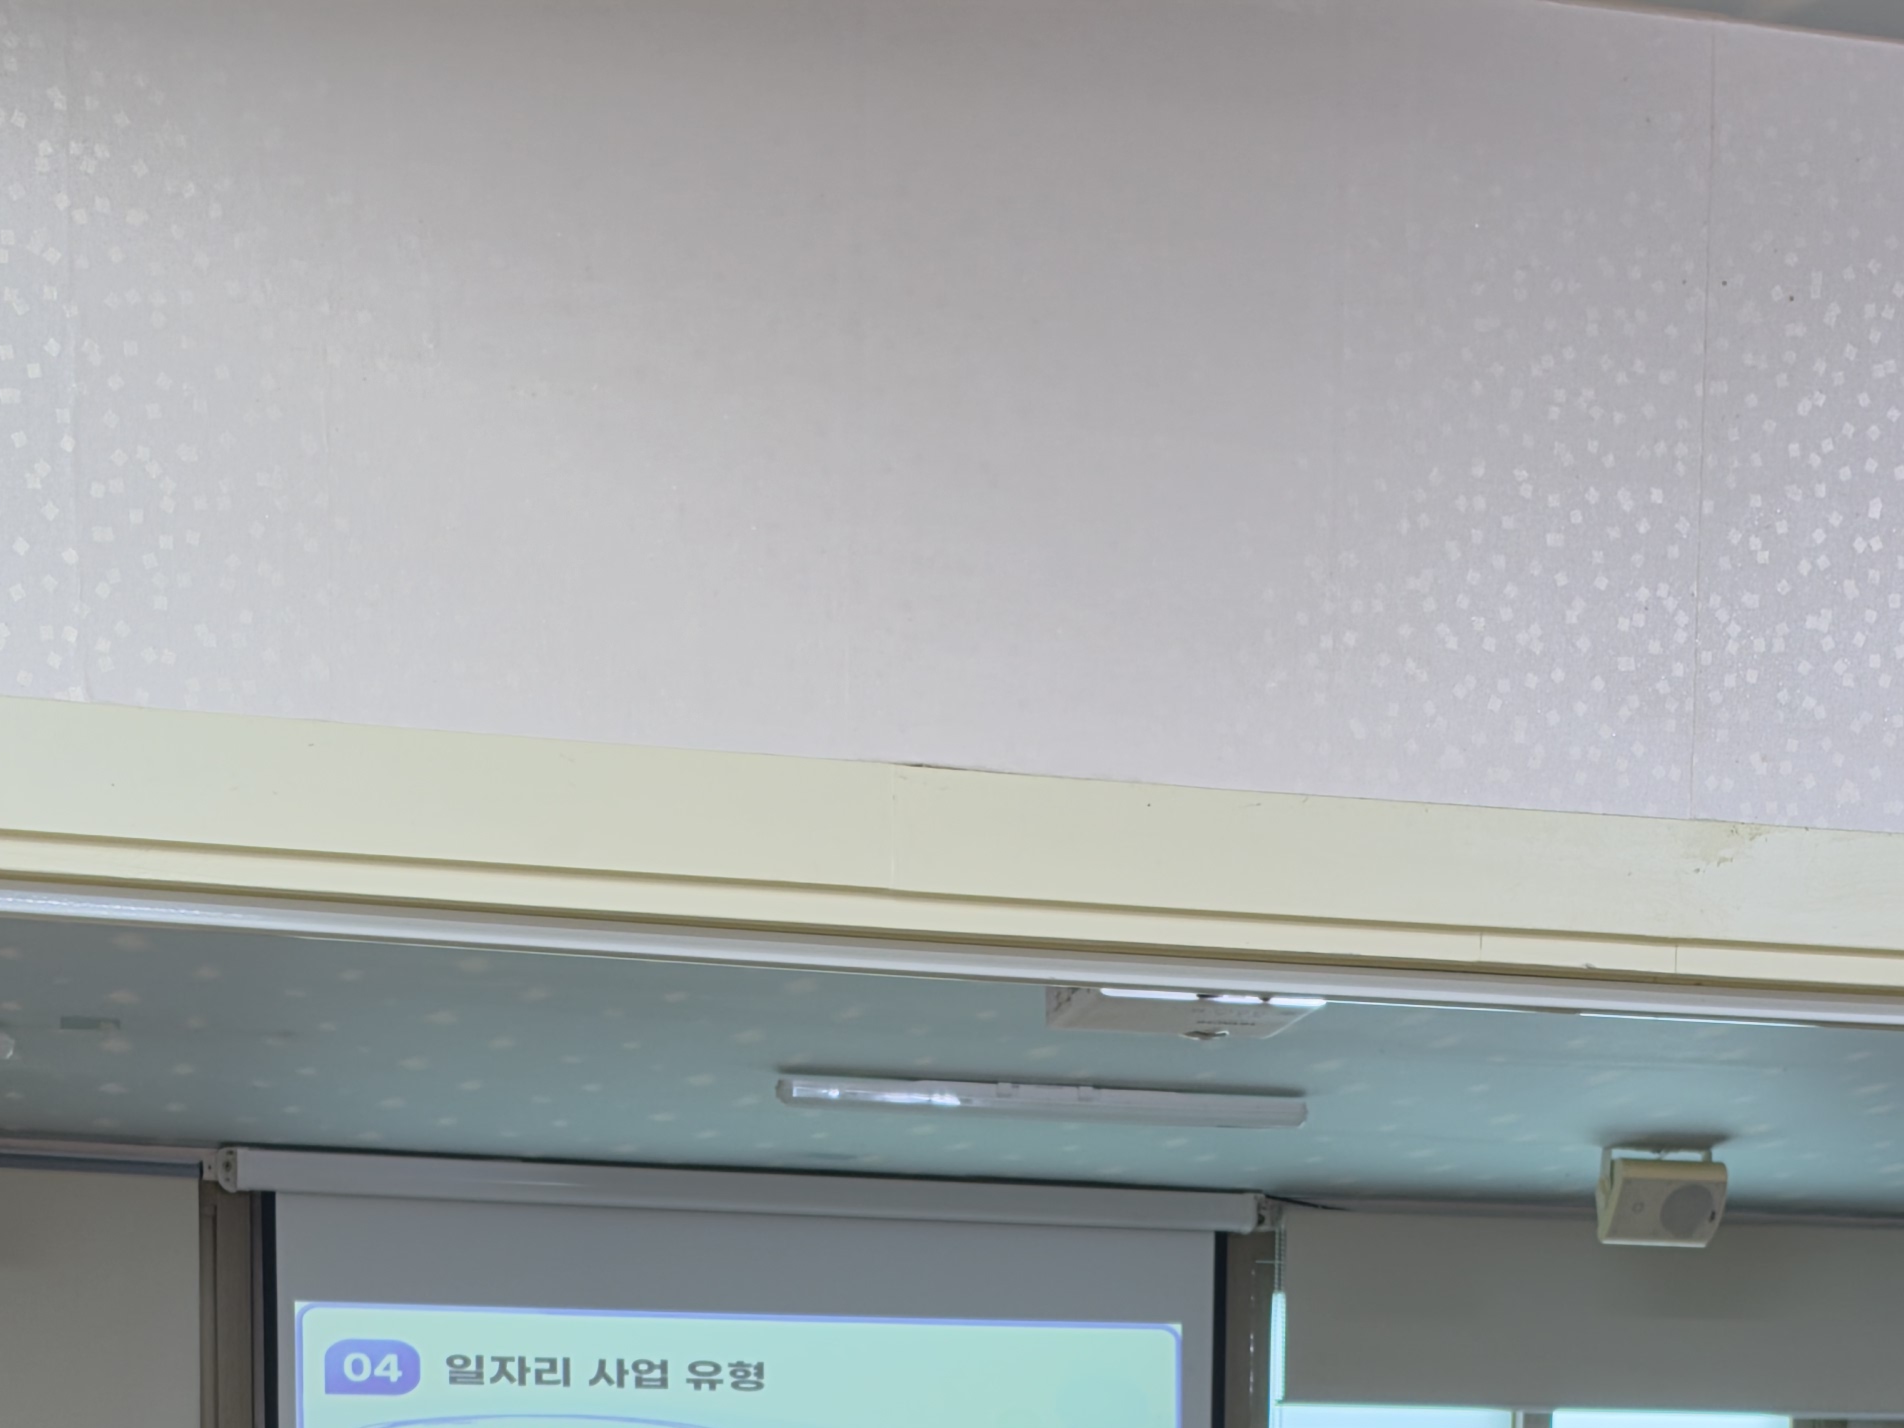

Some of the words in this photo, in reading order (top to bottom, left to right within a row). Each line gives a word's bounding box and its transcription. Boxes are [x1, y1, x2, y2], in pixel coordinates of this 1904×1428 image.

[344, 1353, 402, 1382] 04
[446, 1354, 570, 1387] 일자리
[589, 1358, 668, 1389] 사업
[686, 1360, 764, 1391] 유형
